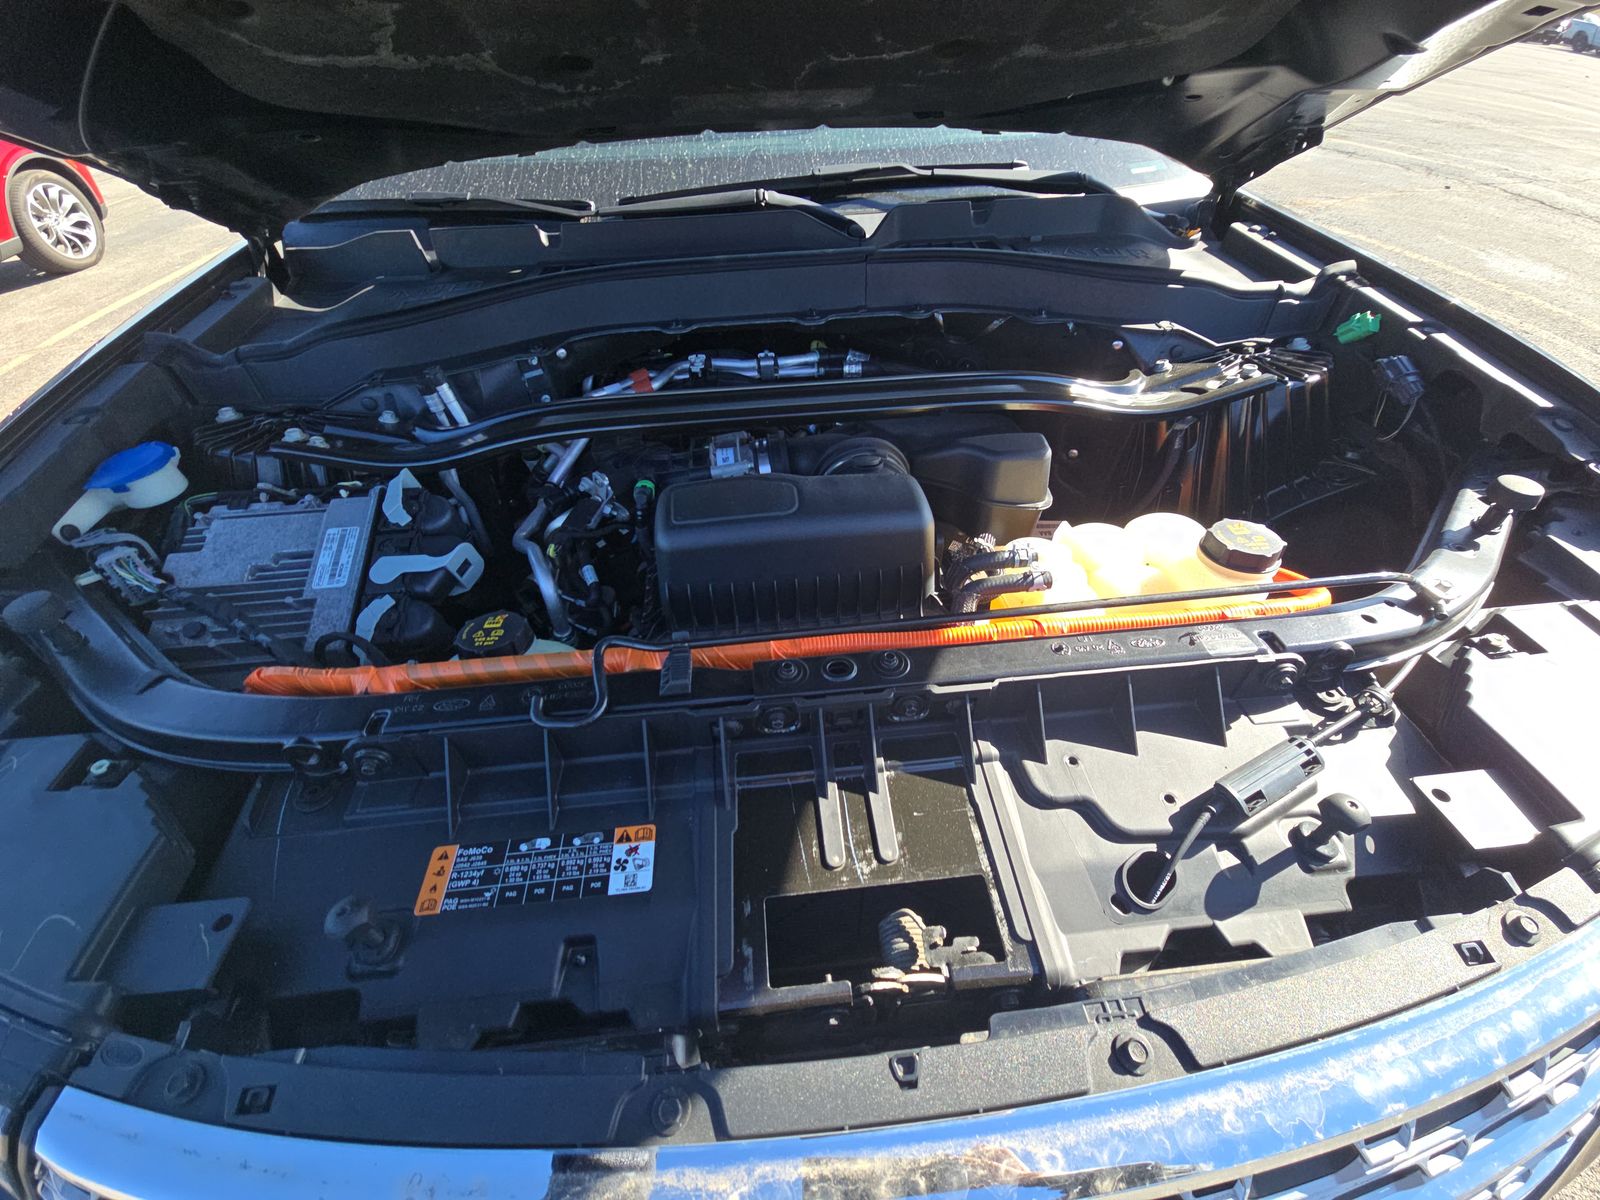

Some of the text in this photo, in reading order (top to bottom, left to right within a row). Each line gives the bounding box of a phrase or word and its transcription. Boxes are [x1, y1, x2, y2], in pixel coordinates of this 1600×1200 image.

[457, 846, 494, 856] FoMoCo
[451, 869, 485, 879] R-1234yf
[449, 880, 471, 889] (GWP
